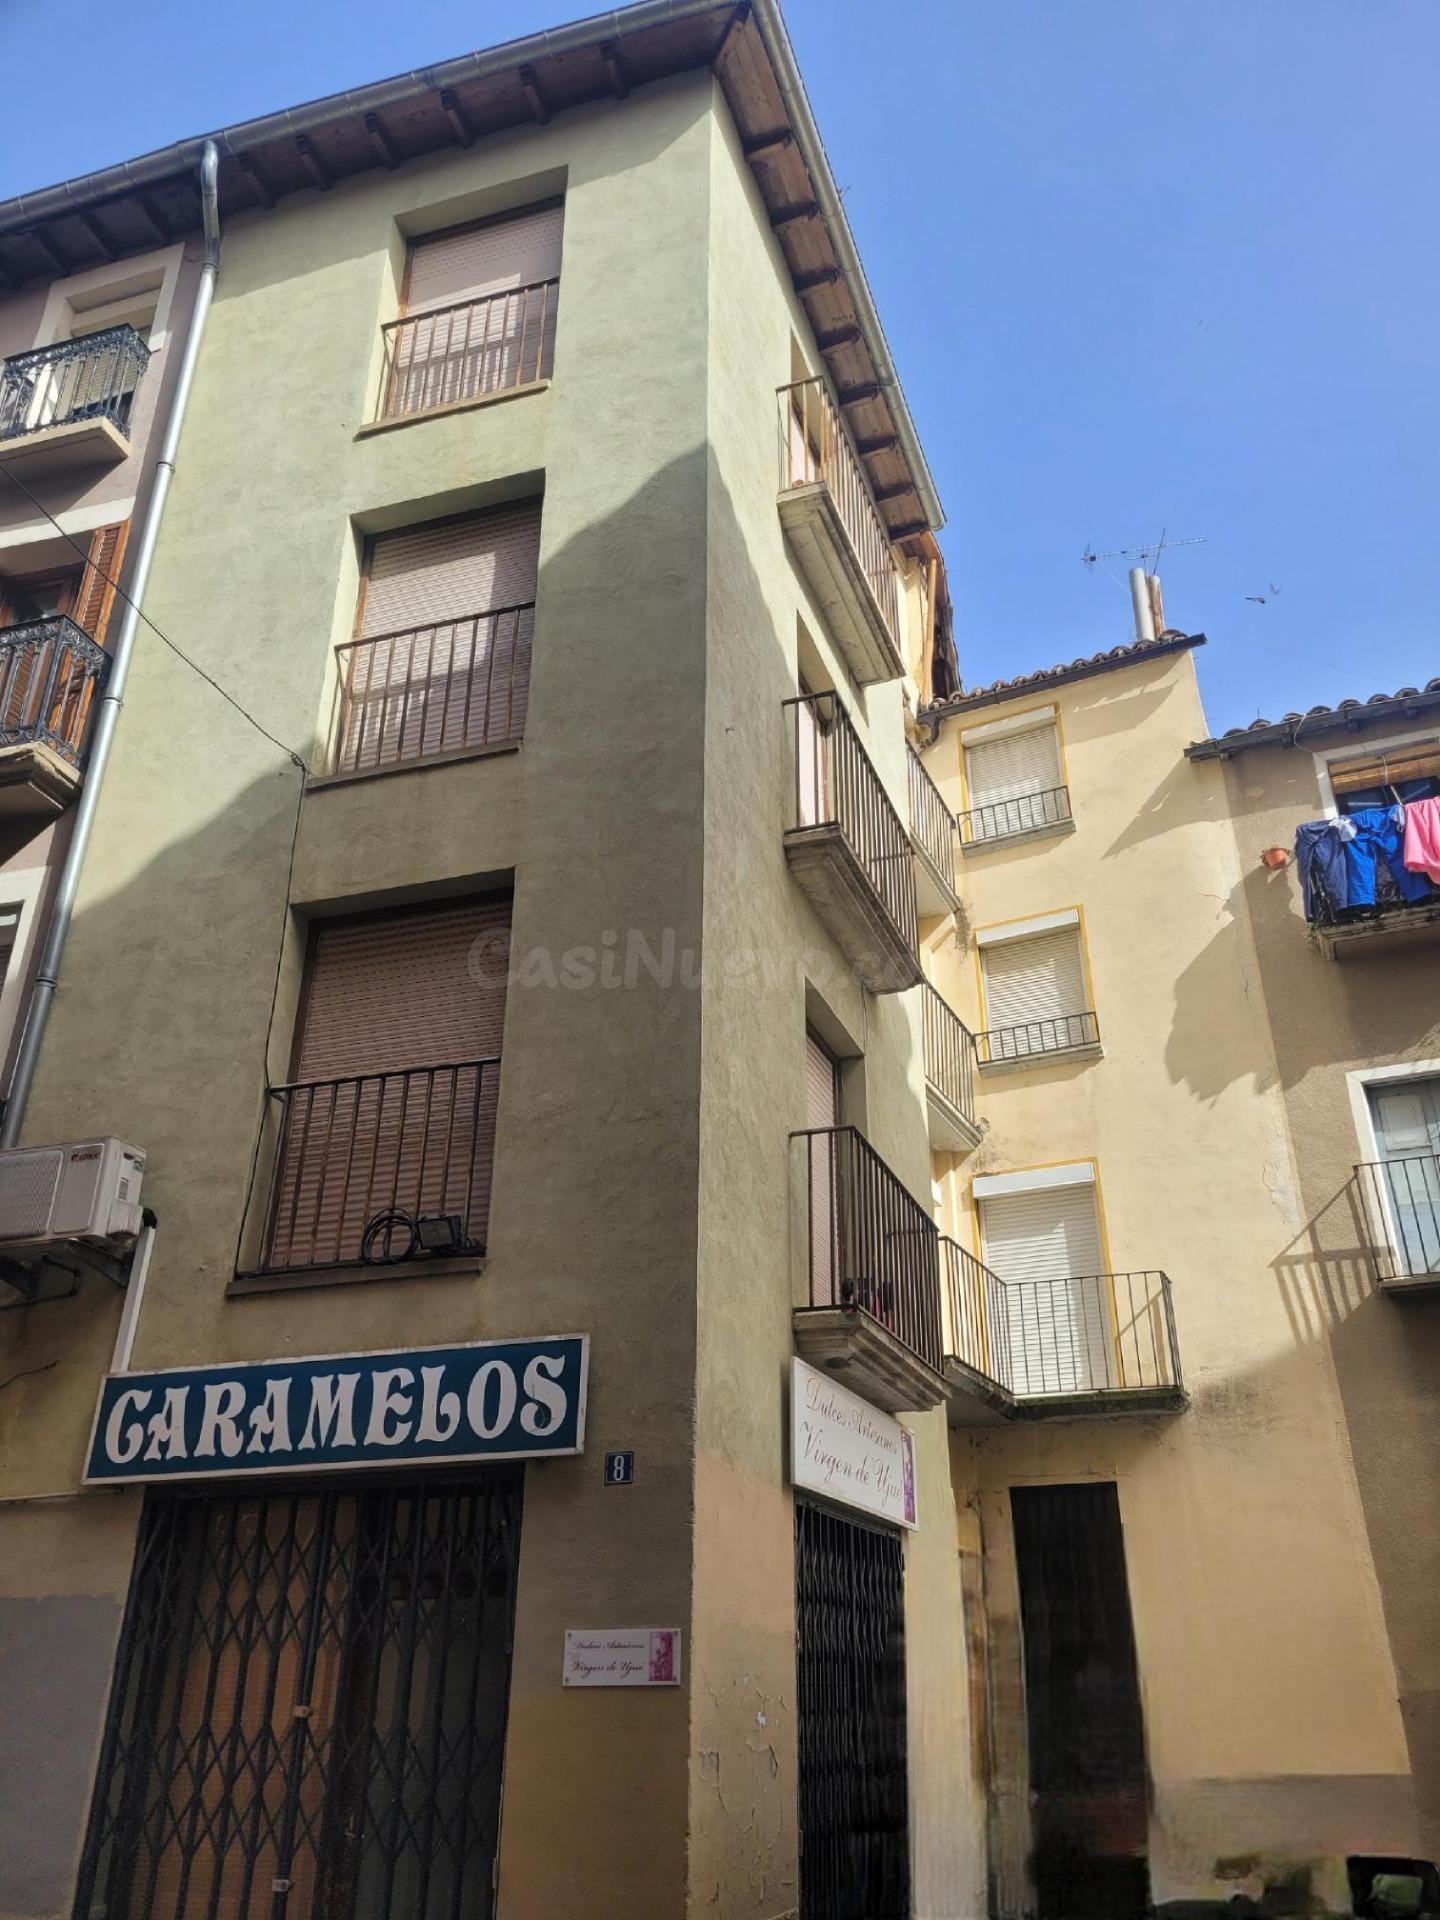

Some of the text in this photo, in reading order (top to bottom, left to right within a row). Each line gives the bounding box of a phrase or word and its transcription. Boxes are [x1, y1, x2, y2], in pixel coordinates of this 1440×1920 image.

[105, 1354, 568, 1464] CARAMELOS
[805, 1376, 846, 1427] Dulces
[613, 1455, 625, 1481] 8
[799, 1420, 852, 1485] Virgen
[855, 1454, 870, 1485] de
